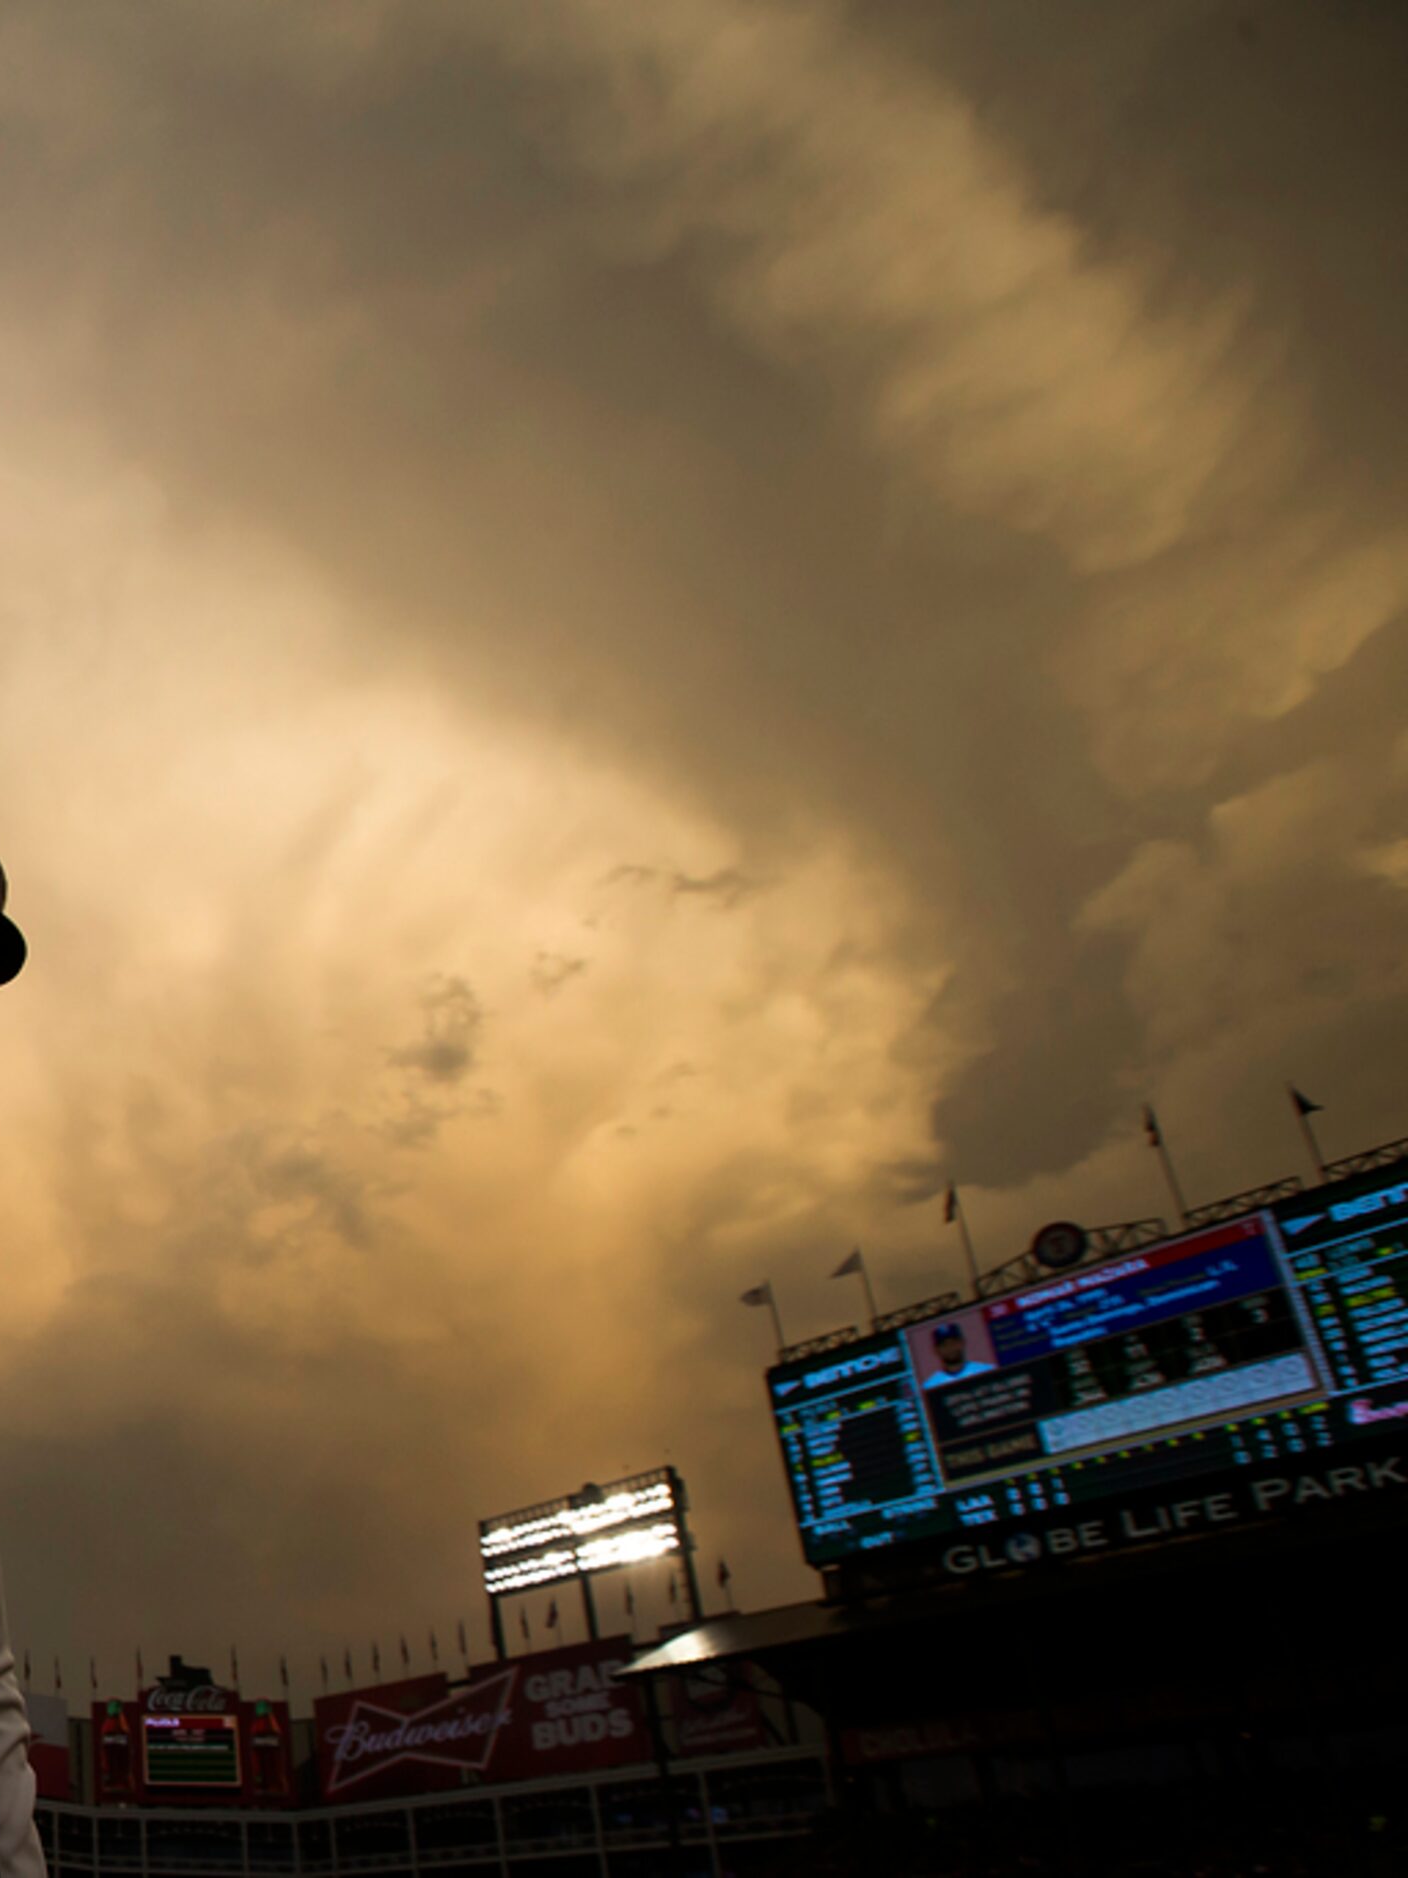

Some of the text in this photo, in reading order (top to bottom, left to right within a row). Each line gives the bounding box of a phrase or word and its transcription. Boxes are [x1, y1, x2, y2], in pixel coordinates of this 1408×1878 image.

[944, 1456, 1408, 1574] GLOBE LIFE PARK
[324, 1706, 513, 1762] Budweiser
[532, 1708, 634, 1751] BUDS
